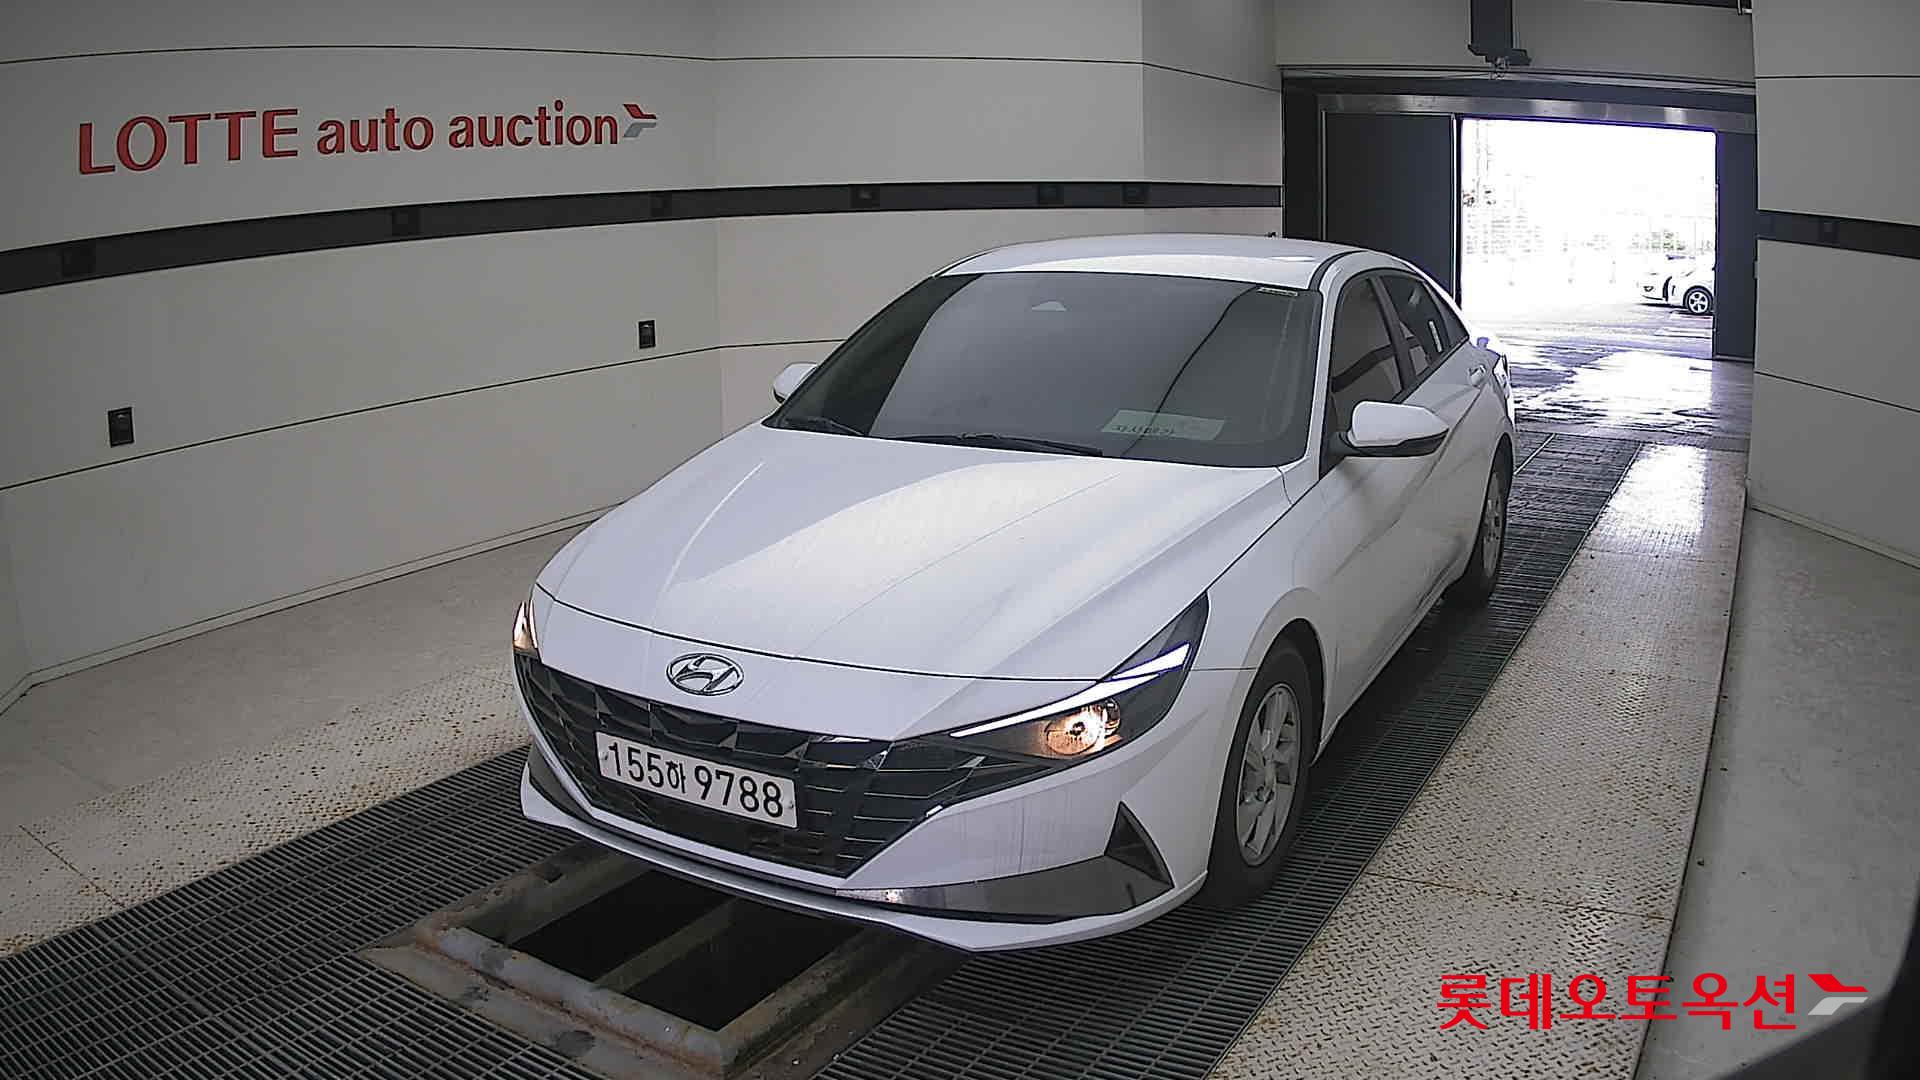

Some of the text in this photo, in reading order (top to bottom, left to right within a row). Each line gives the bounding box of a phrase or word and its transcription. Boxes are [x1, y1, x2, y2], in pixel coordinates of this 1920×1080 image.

[79, 99, 619, 175] LOTTE auto auction
[608, 741, 784, 818] 155하 9788
